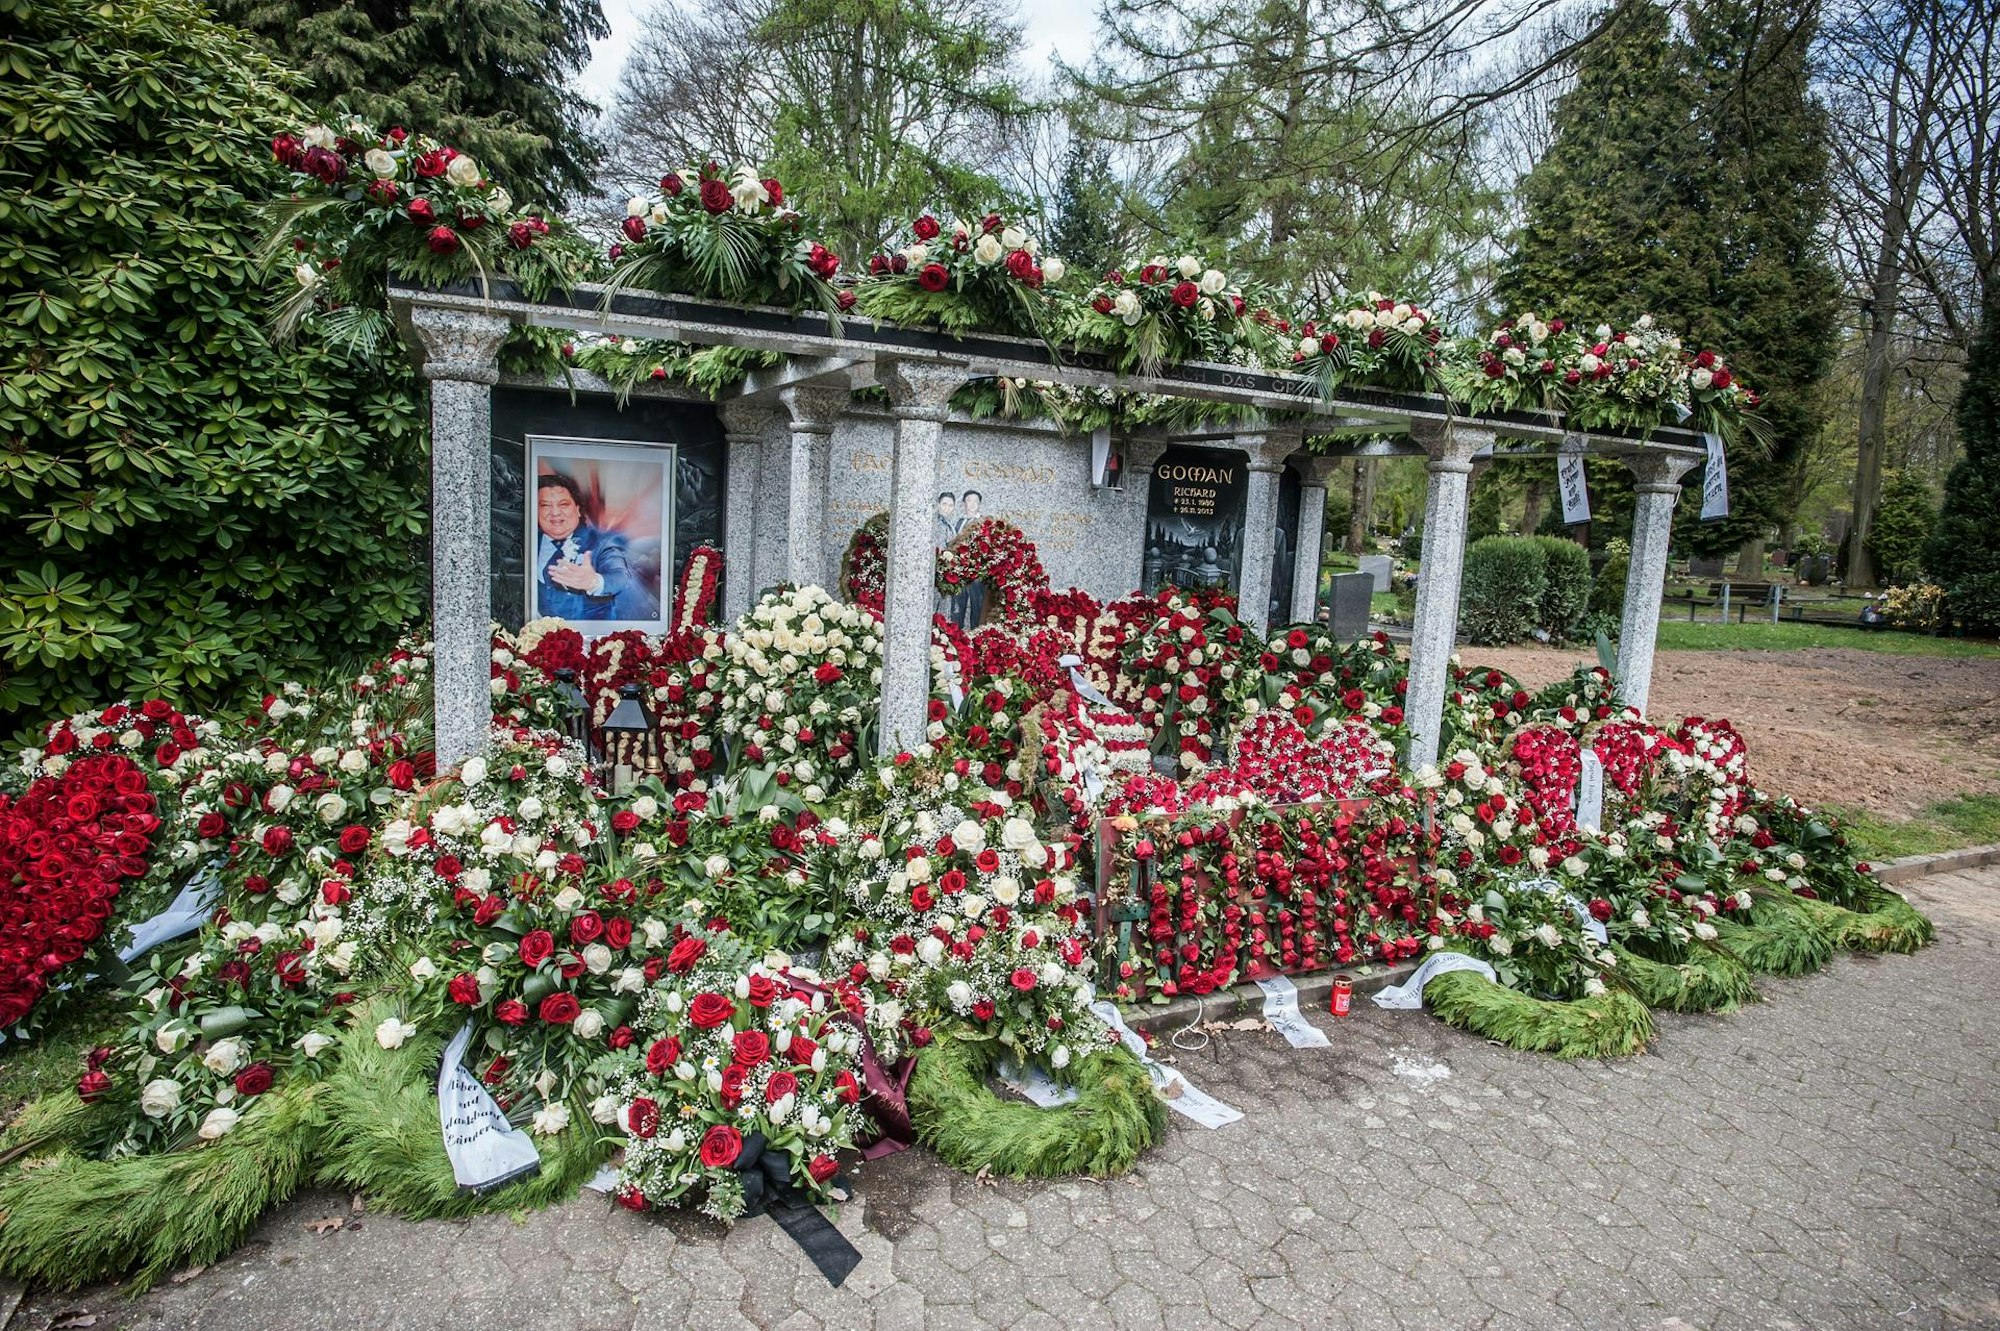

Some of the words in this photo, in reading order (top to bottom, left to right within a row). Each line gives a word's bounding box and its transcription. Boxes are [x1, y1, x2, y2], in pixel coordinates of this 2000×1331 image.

[1222, 372, 1255, 389] DAS
[1158, 464, 1234, 484] GOMAN
[1174, 486, 1216, 498] RICHARD
